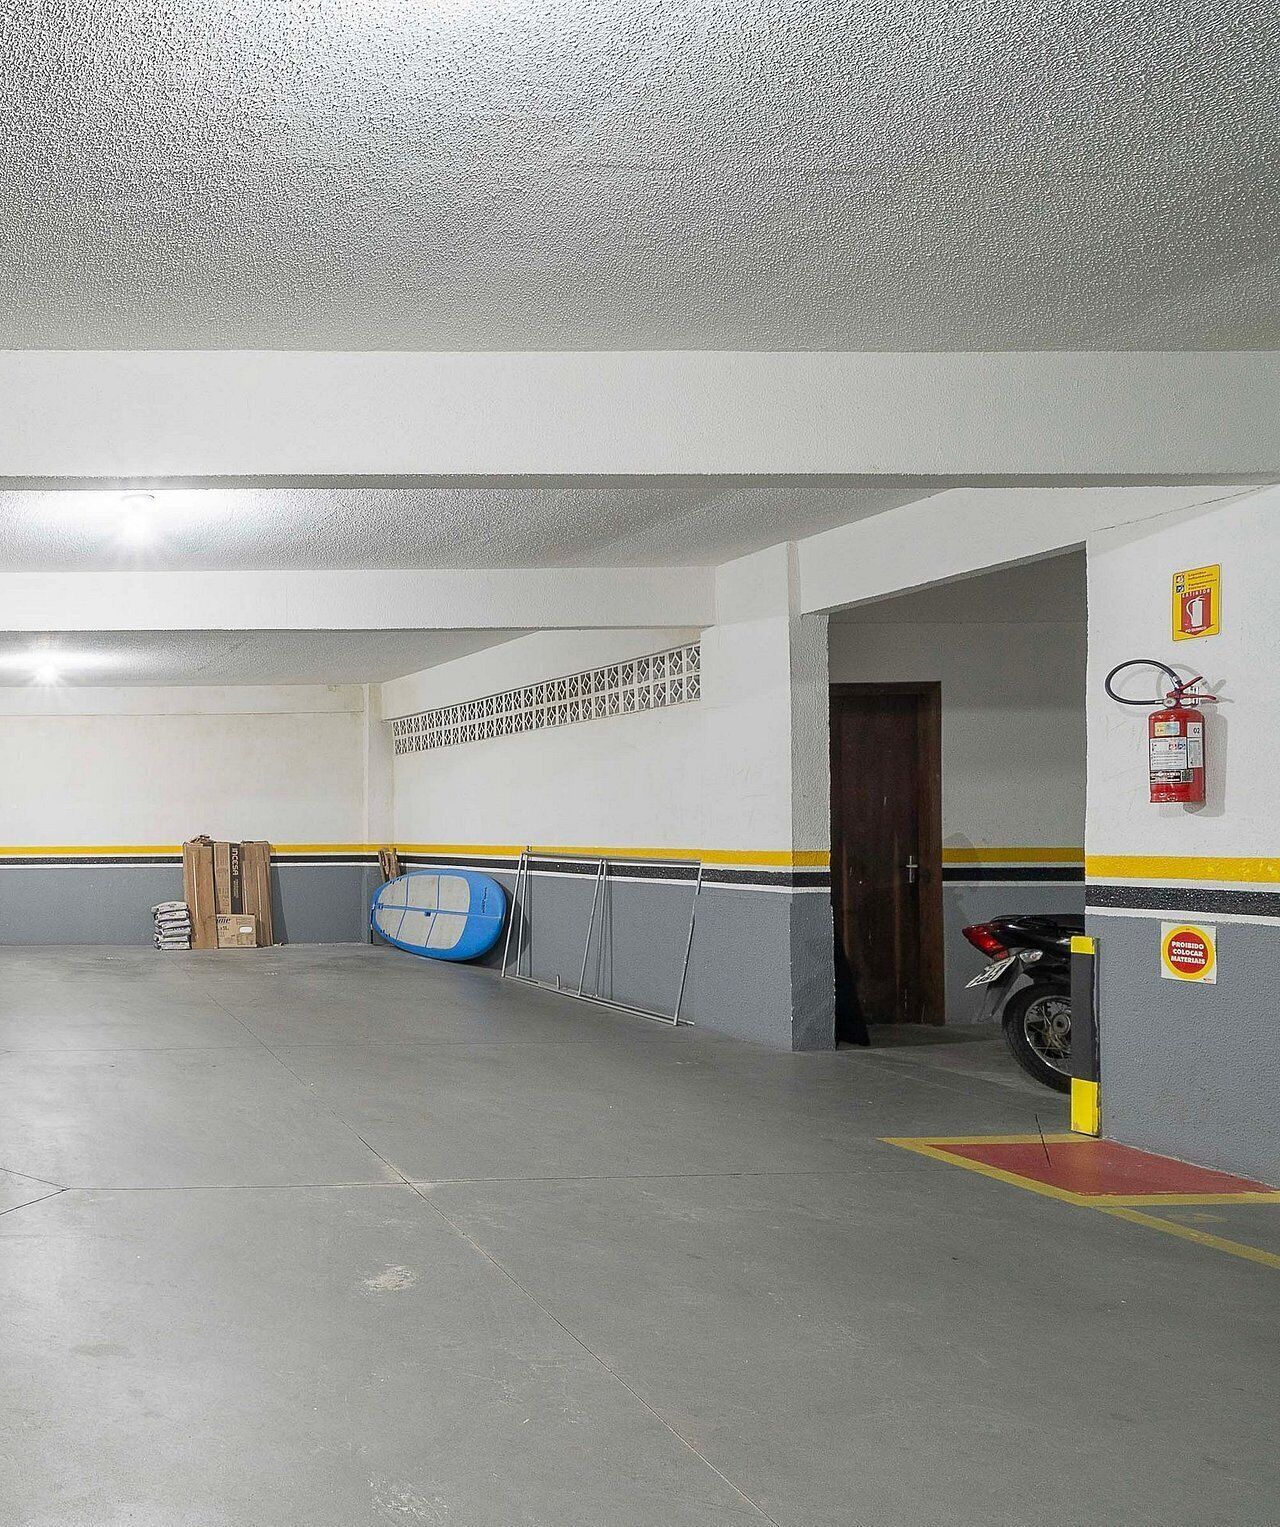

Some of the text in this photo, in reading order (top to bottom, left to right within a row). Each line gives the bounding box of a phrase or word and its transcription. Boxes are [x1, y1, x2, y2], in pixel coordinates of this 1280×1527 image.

[1171, 941, 1204, 950] PROIBIDO
[1172, 949, 1203, 957] COLOCAR
[1171, 956, 1205, 964] MATERIAIS
